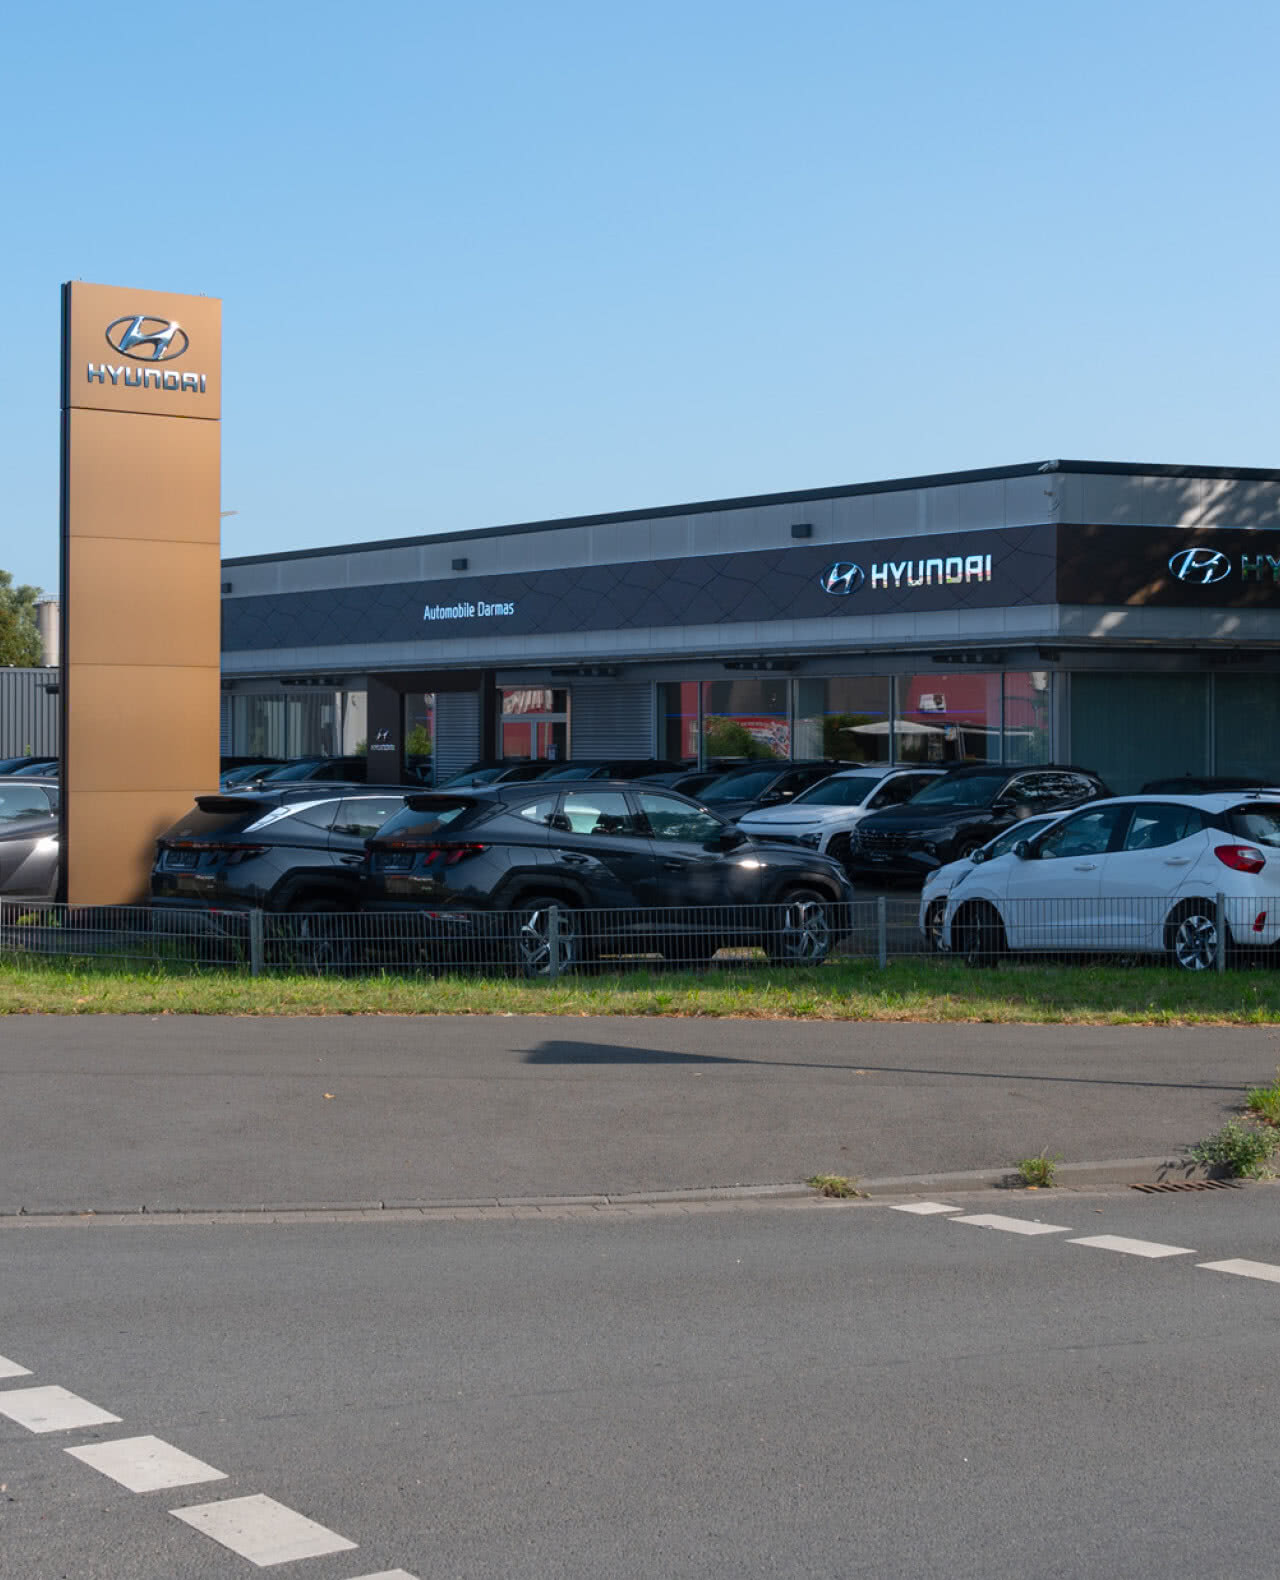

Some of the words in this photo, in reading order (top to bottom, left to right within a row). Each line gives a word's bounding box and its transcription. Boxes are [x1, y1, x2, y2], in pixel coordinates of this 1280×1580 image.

[87, 362, 207, 393] HYUNDAI
[871, 554, 992, 589] HYUNDAI
[423, 602, 475, 620] Automobile
[477, 601, 514, 617] Darmas
